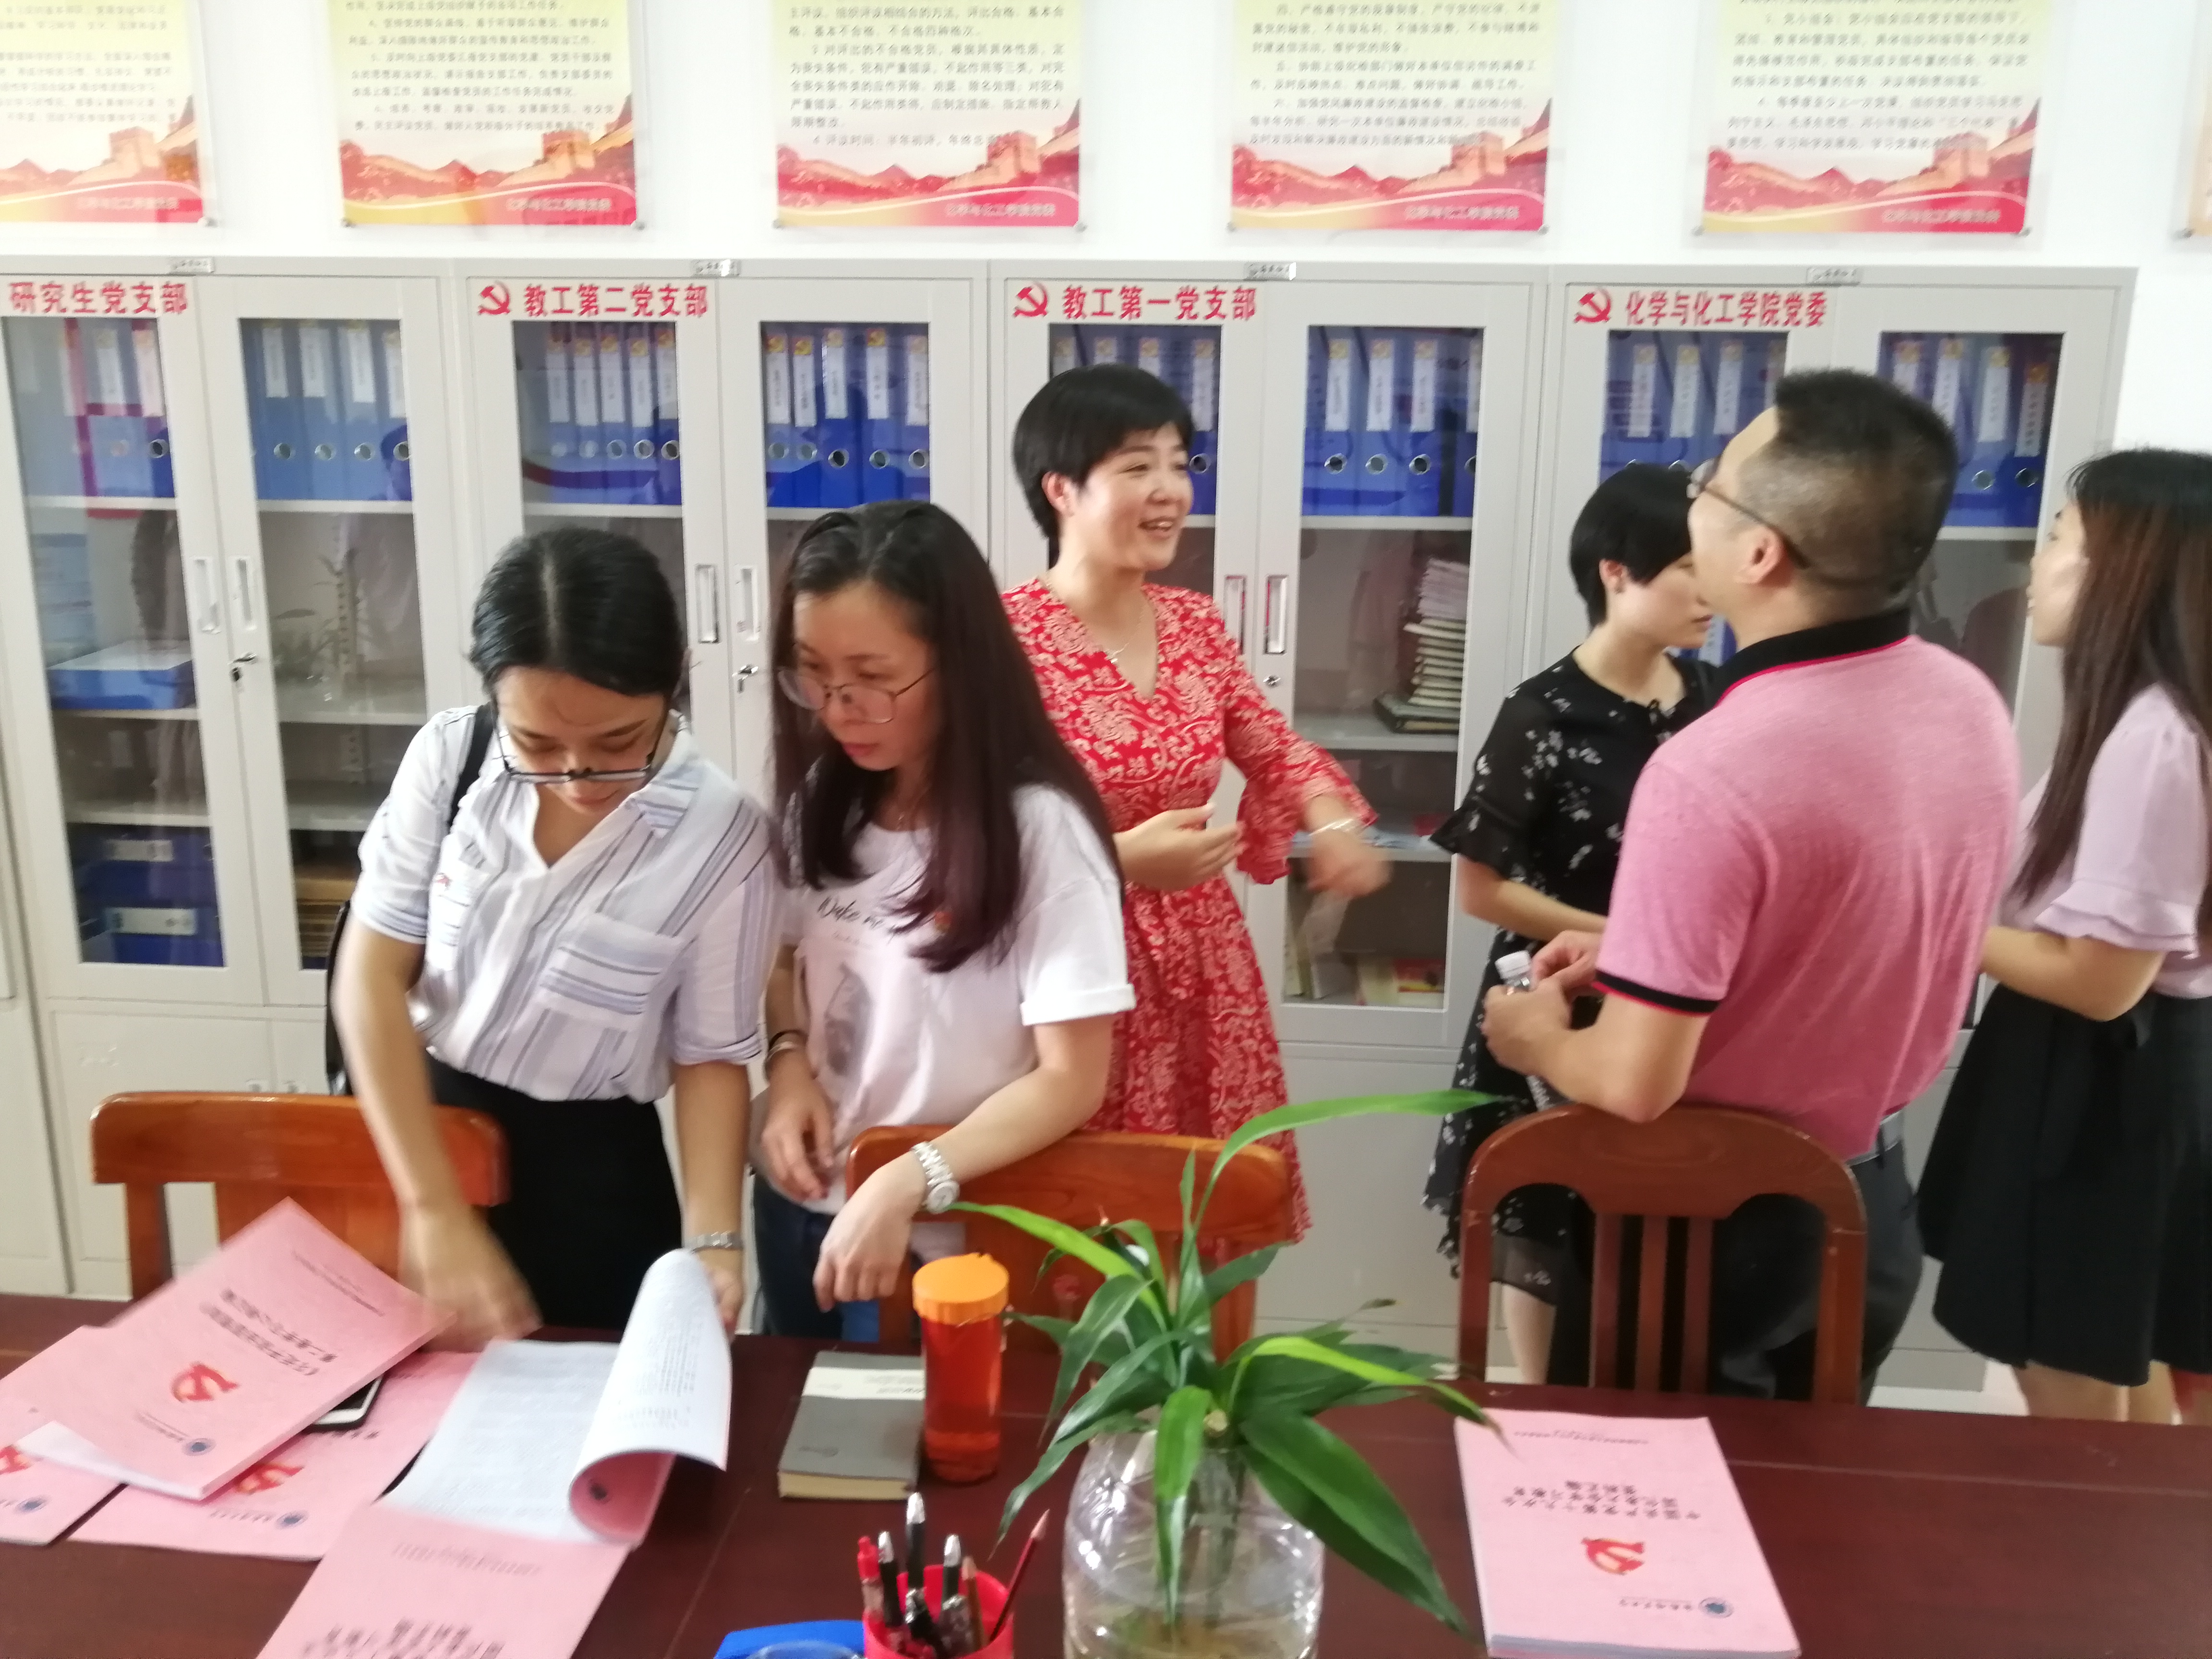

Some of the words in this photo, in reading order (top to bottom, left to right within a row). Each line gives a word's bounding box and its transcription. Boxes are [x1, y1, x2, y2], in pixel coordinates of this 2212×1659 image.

[10, 280, 188, 314] 研究生党支部
[524, 282, 709, 318] 教工第二党支部
[1061, 284, 1257, 321] 教工第一党支部
[1626, 290, 1827, 327] 化学与化工学院党委
